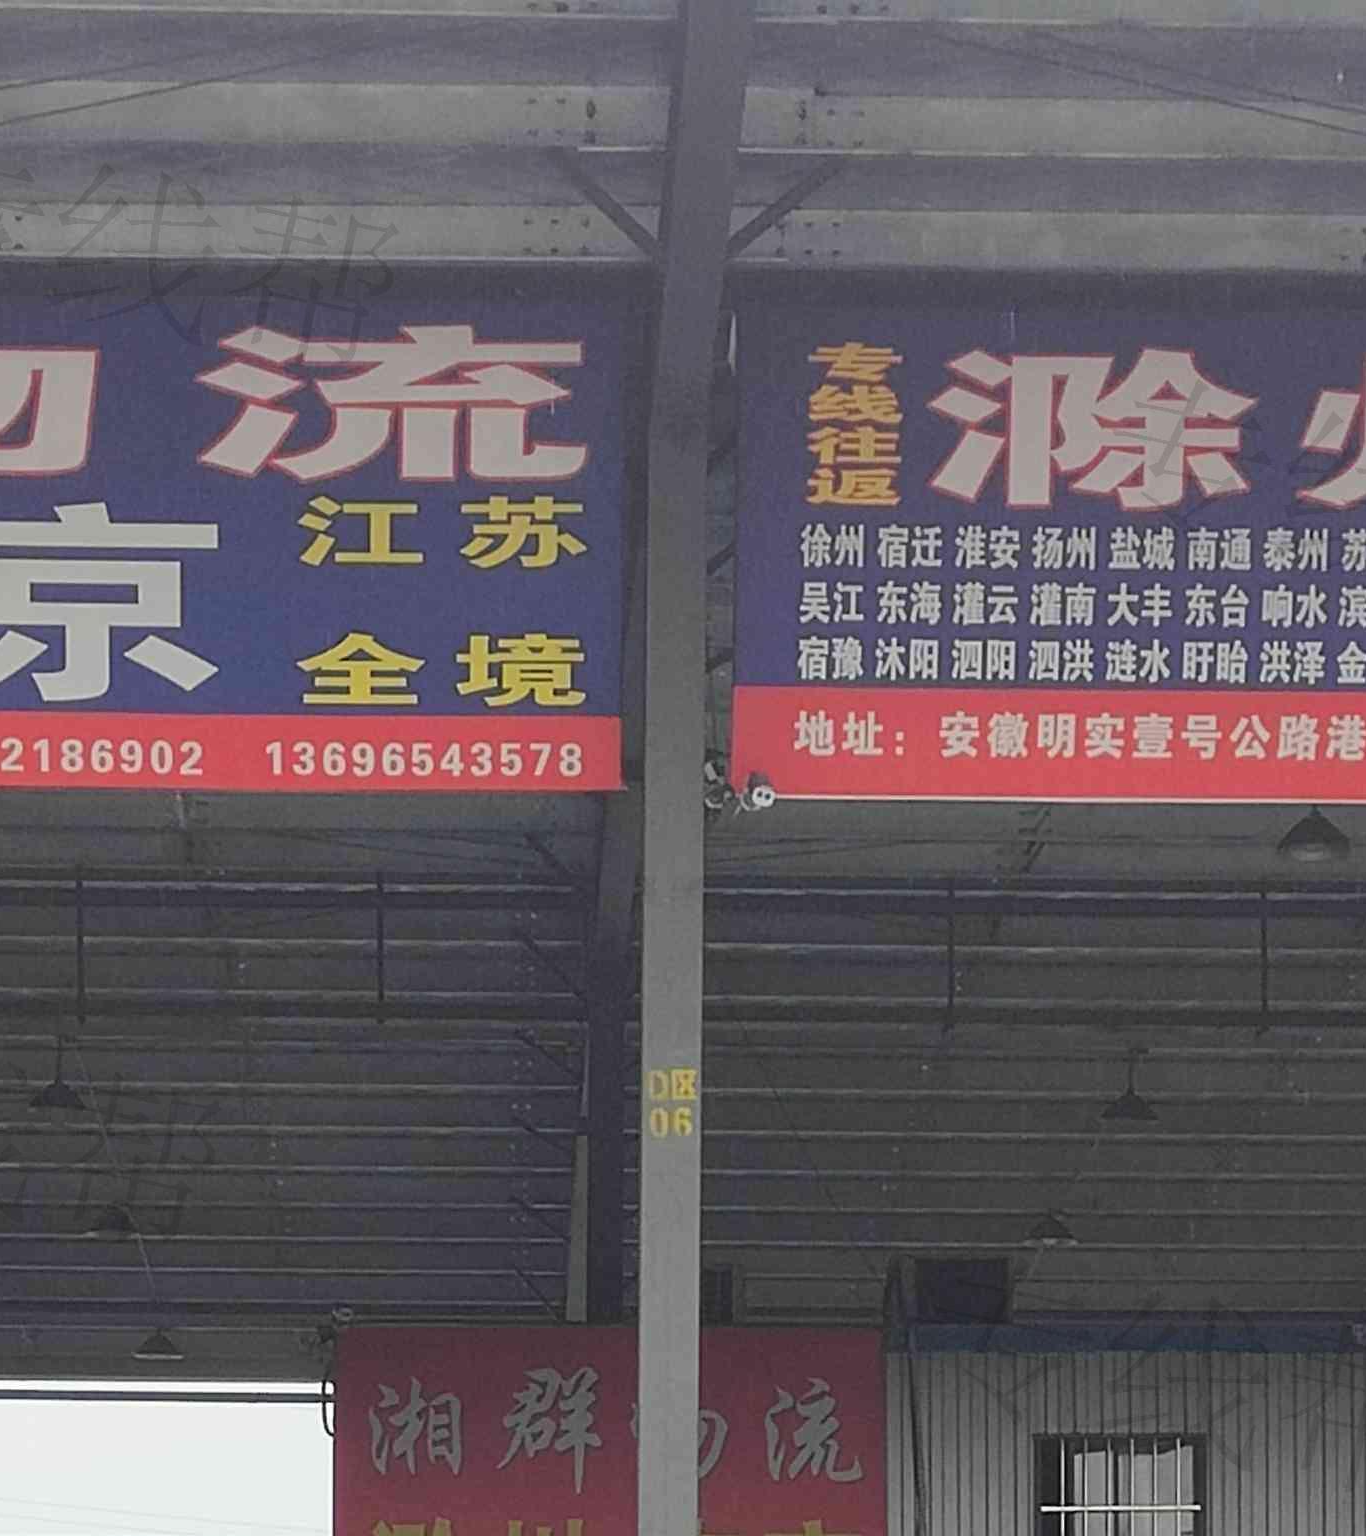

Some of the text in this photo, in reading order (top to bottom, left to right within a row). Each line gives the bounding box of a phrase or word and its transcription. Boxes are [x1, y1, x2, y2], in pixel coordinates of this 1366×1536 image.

[805, 340, 904, 509] 专线往返
[295, 494, 588, 569] 江苏
[800, 523, 864, 568] 徐州
[877, 524, 943, 569] 宿迁
[954, 525, 1021, 569] 淮安
[1031, 526, 1096, 571] 扬州
[1108, 525, 1175, 571] 盐城
[1187, 526, 1252, 571] 南通
[1263, 527, 1328, 572] 泰州
[799, 581, 864, 624] 吴江
[877, 580, 942, 626] 东海
[1107, 582, 1173, 628] 大丰
[1185, 583, 1249, 628] 东台
[1261, 583, 1327, 629] 响水
[295, 631, 588, 709] 全境
[951, 639, 1016, 681] 泗阳
[1028, 638, 1094, 682] 泗洪
[1259, 640, 1326, 685] 洪泽
[263, 740, 586, 780] 13696543578
[650, 1106, 693, 1138] 06
